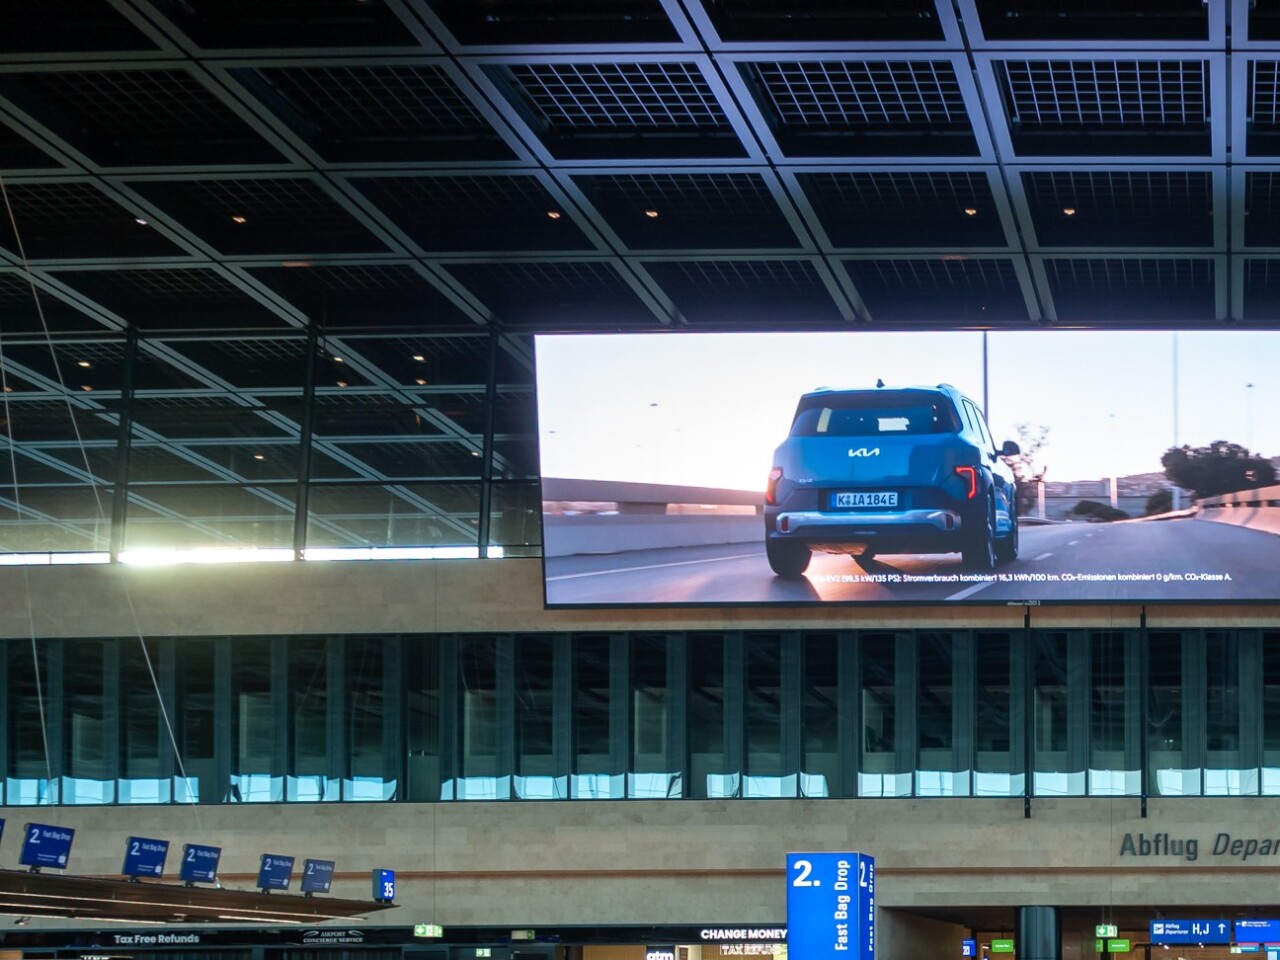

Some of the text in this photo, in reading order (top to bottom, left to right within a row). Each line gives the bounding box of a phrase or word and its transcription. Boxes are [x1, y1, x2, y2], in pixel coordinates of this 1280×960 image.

[903, 574, 959, 582] Stromverbrauch
[960, 574, 997, 582] kombiniert
[1119, 833, 1198, 861] Abflug
[792, 859, 821, 887] 2.
[384, 882, 394, 897] 35
[834, 860, 851, 951] Fast Bag Drop
[114, 933, 200, 943] Tax Free Refunds
[700, 929, 788, 939] CHANGE MONEY
[722, 944, 744, 955] TAX
